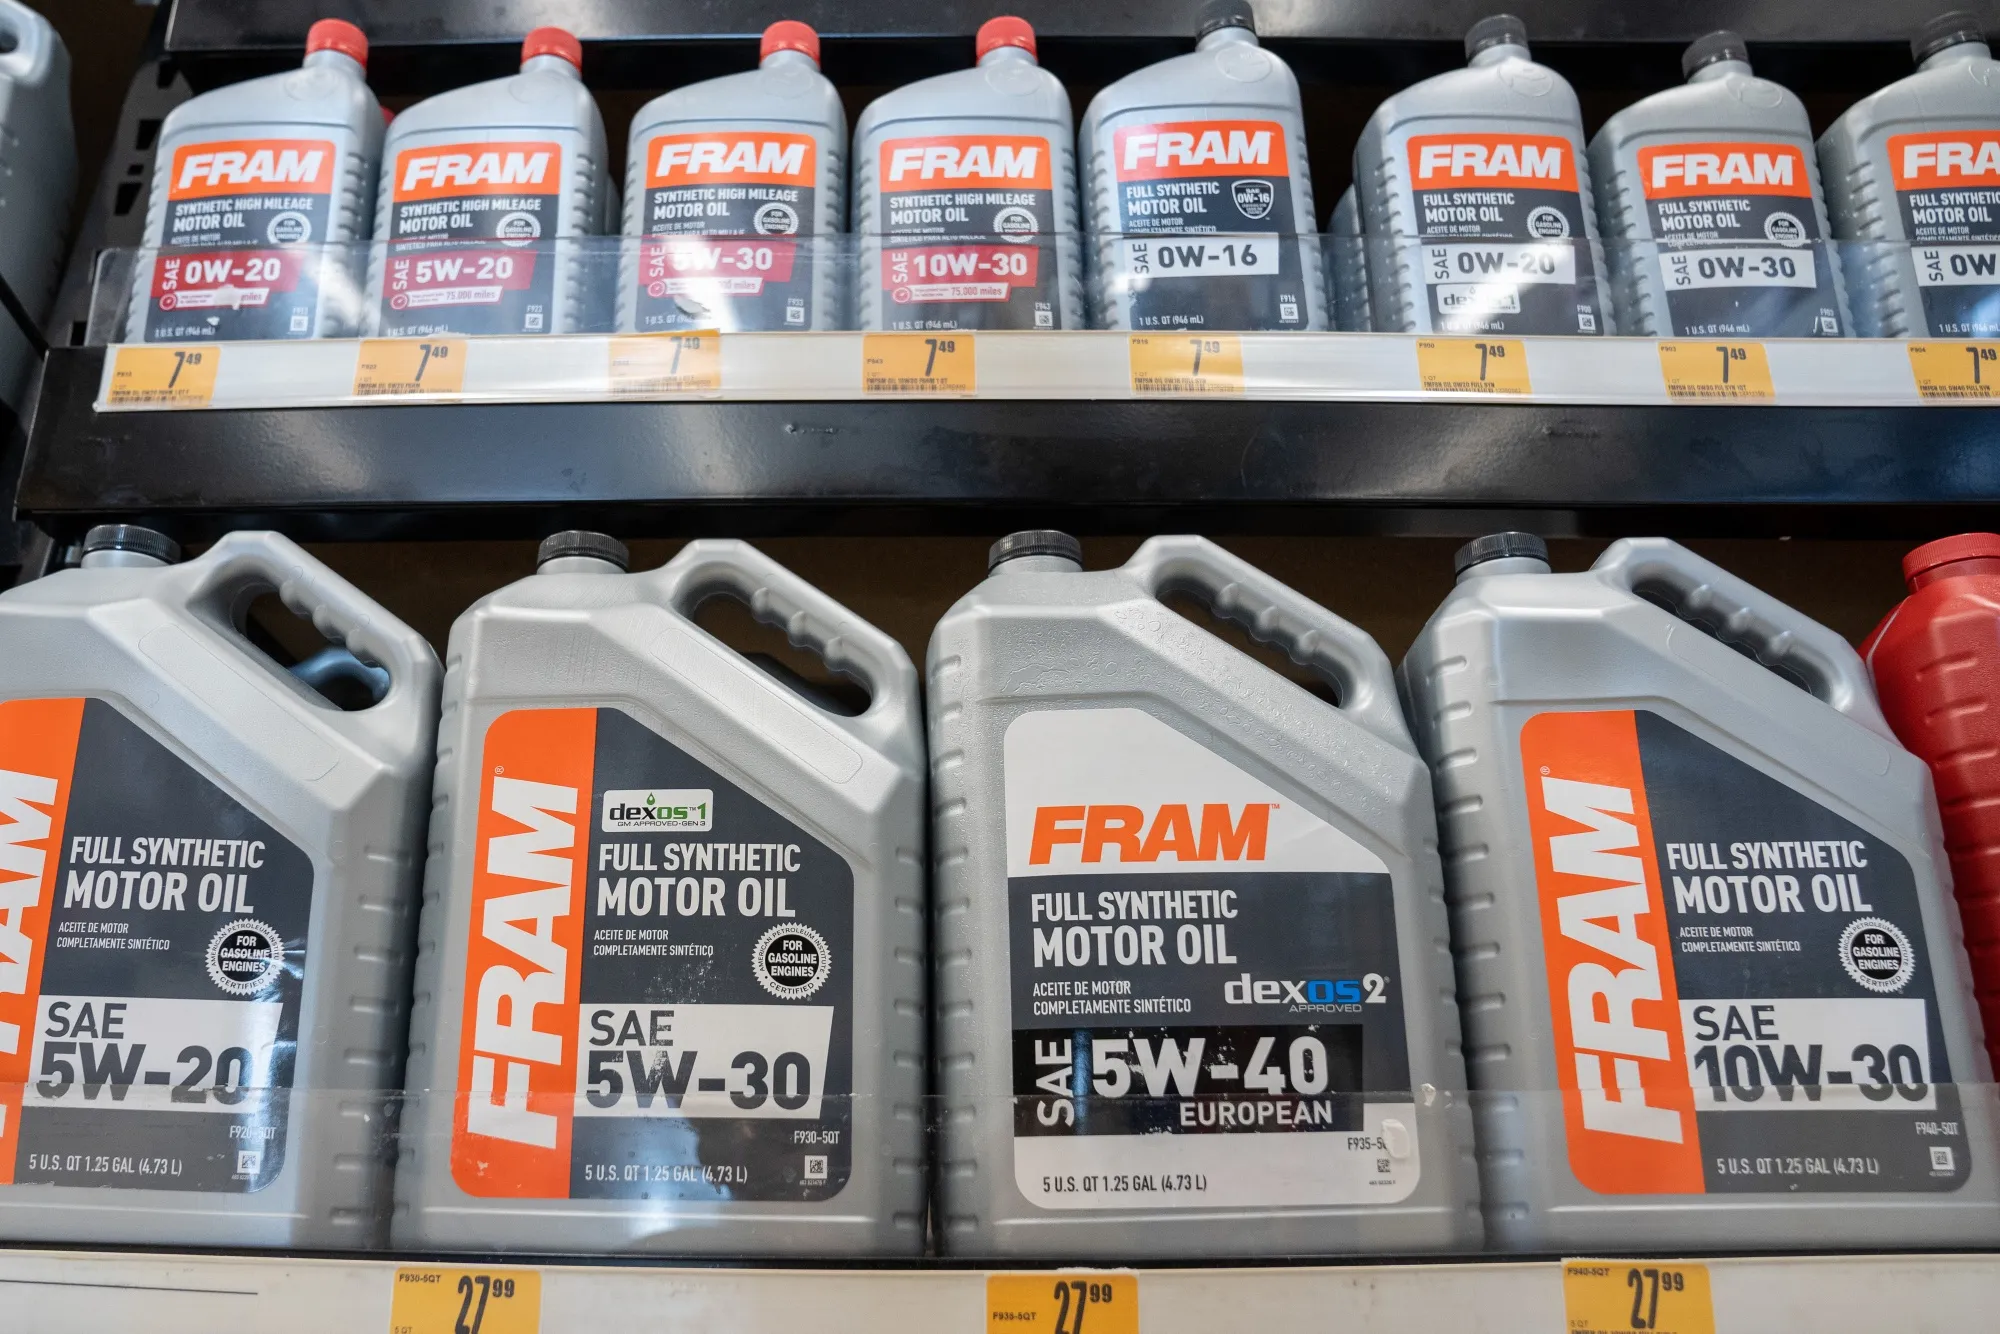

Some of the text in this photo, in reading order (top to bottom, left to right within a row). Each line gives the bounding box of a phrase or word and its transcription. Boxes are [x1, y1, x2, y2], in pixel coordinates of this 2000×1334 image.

[655, 141, 807, 177] FRAM
[1123, 130, 1271, 170] FRAM
[1419, 144, 1561, 179] FRAM
[178, 150, 323, 189] FRAM
[401, 152, 550, 191] FRAM
[889, 146, 1038, 182] FRAM
[1652, 153, 1794, 189] FRAM
[654, 188, 799, 204] SYNTHETIC HIGH MILEAGE
[890, 193, 1036, 210] SYNTHETIC HIGH MILEAGE
[1127, 182, 1220, 199] FULL SYNTHETIC
[1423, 192, 1515, 207] FULL SYNTHETIC
[1909, 193, 1939, 208] FULL
[175, 198, 313, 217] SYNTHETIC HIGH MILEAGE
[401, 199, 542, 218] SYNTHETIC HIGH MILEAGE
[653, 202, 730, 221] MOTOR OIL
[891, 207, 969, 226] MOTOR OIL
[1128, 197, 1207, 216] MOTOR OIL
[1425, 206, 1503, 223] MOTOR OIL
[1658, 200, 1751, 215] FULL SYNTHETIC
[1912, 207, 1992, 225] MOTOR OIL
[173, 213, 245, 233] MOTOR OIL
[399, 213, 473, 234] MOTOR OIL
[1661, 214, 1741, 232] MOTOR OIL
[650, 246, 665, 277] SAE
[892, 252, 908, 283] SAE
[913, 253, 1028, 277] 10W-30
[1132, 243, 1149, 274] SAE
[1158, 244, 1258, 268] 0W-16
[1432, 248, 1449, 280] SAE
[1457, 251, 1556, 275] 0W-20
[1699, 257, 1796, 279] 0W-30
[162, 259, 180, 290] SAE
[184, 258, 282, 284] 0W-20
[392, 259, 409, 290] SAE
[415, 256, 513, 284] 5W-20
[1672, 255, 1691, 285] SAE
[1146, 316, 1160, 326] U.S.
[1172, 315, 1188, 325] (946
[1189, 315, 1204, 325] mL)
[1029, 803, 1270, 865] FRAM
[70, 836, 265, 869] FULL SYNTHETIC
[599, 843, 801, 872] FULL SYNTHETIC
[1666, 840, 1868, 870] FULL SYNTHETIC
[63, 870, 254, 914] MOTOR OIL
[597, 877, 796, 918] MOTOR OIL
[1672, 874, 1873, 914] MOTOR OIL
[1031, 890, 1238, 922] FULL SYNTHETIC
[58, 921, 129, 934] ACEITE DE MOTOR
[594, 929, 669, 940] ACEITE DE MOTOR
[1864, 934, 1885, 945] FOR
[56, 937, 170, 950] COMPLETAMENTE SINTÉTICO
[593, 942, 714, 957] COMPLETAMENTE SINTÉTICO
[758, 927, 827, 973] AMERICAN PETROLEUM INSTITUTE
[783, 940, 803, 951] FOR
[1033, 924, 1237, 967] MOTOR OIL
[1853, 947, 1900, 957] GASOLINE
[467, 776, 578, 1150] FRAM
[767, 952, 818, 964] GASOLINE
[1541, 776, 1684, 1144] FRAM
[1858, 959, 1899, 970] ENGINES
[771, 965, 814, 977] ENGINES
[769, 981, 815, 994] CERTIFIED
[1033, 981, 1131, 996] ACEITE DE MOTOR
[1034, 997, 1191, 1015] COMPLETAMENTE SINTÉTICO
[1289, 1004, 1362, 1013] APPROVED
[44, 1001, 127, 1039] SAE
[589, 1009, 674, 1046] SAE
[1693, 1005, 1779, 1041] SAE
[36, 1040, 252, 1106] 5W-20
[1092, 1036, 1328, 1098] 5W-40
[1694, 1044, 1928, 1102] 10W-30
[586, 1050, 810, 1110] 5W-30
[1035, 1038, 1074, 1127] SAE
[1179, 1100, 1333, 1126] EUROPEAN
[794, 1131, 840, 1144] F930-5QT
[585, 1165, 748, 1183] 5 U.S. QT 1.25 GAL (4.73 L)
[1043, 1174, 1206, 1192] 5 U.S. QT 1.25 GAL (4.73 L)
